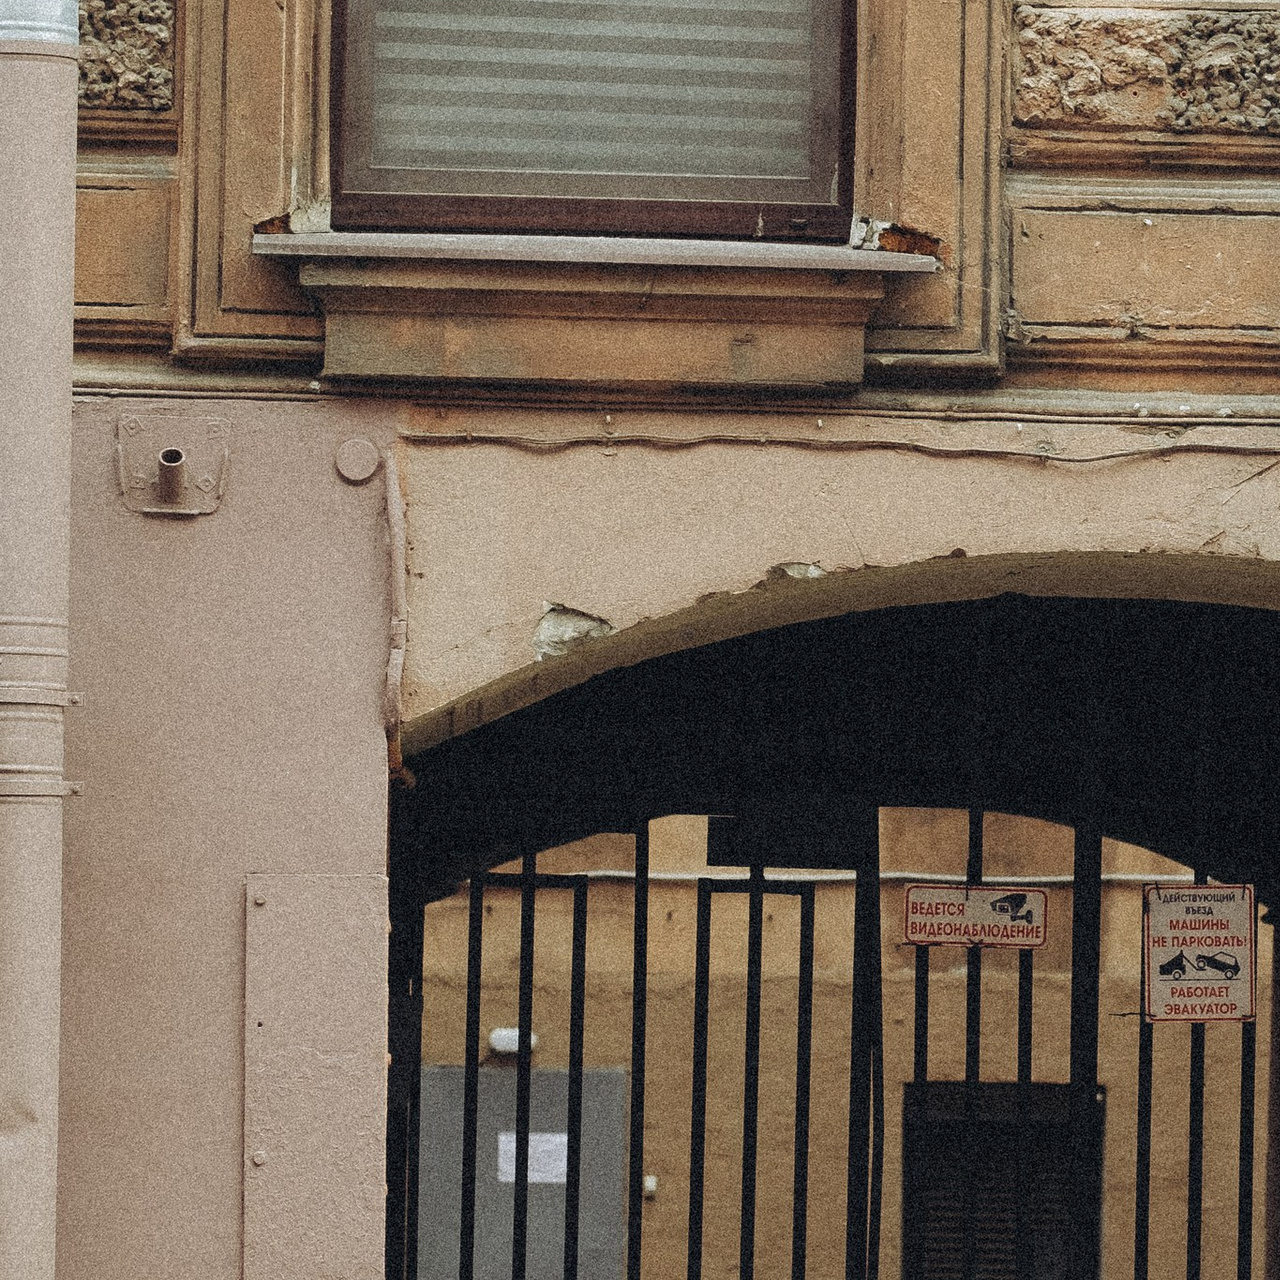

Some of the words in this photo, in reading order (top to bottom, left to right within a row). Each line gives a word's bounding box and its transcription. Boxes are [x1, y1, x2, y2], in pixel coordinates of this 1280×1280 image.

[1162, 891, 1236, 904] ДЕЙСТВУЮЩИЙ
[911, 902, 965, 917] ВЕДЕТСЯ
[1185, 906, 1214, 915] ВЪЕЗД
[910, 922, 1042, 939] ВИДЕОНАБЛЮДЕНИЕ
[1169, 919, 1230, 931] МАШИНЫ
[1152, 936, 1167, 947] НЕ
[1172, 935, 1247, 947] ПАРКОВАТЬ!
[1170, 987, 1230, 998] РАБОТАЕТ
[1164, 1003, 1238, 1015] ЭВАКУАТОР
